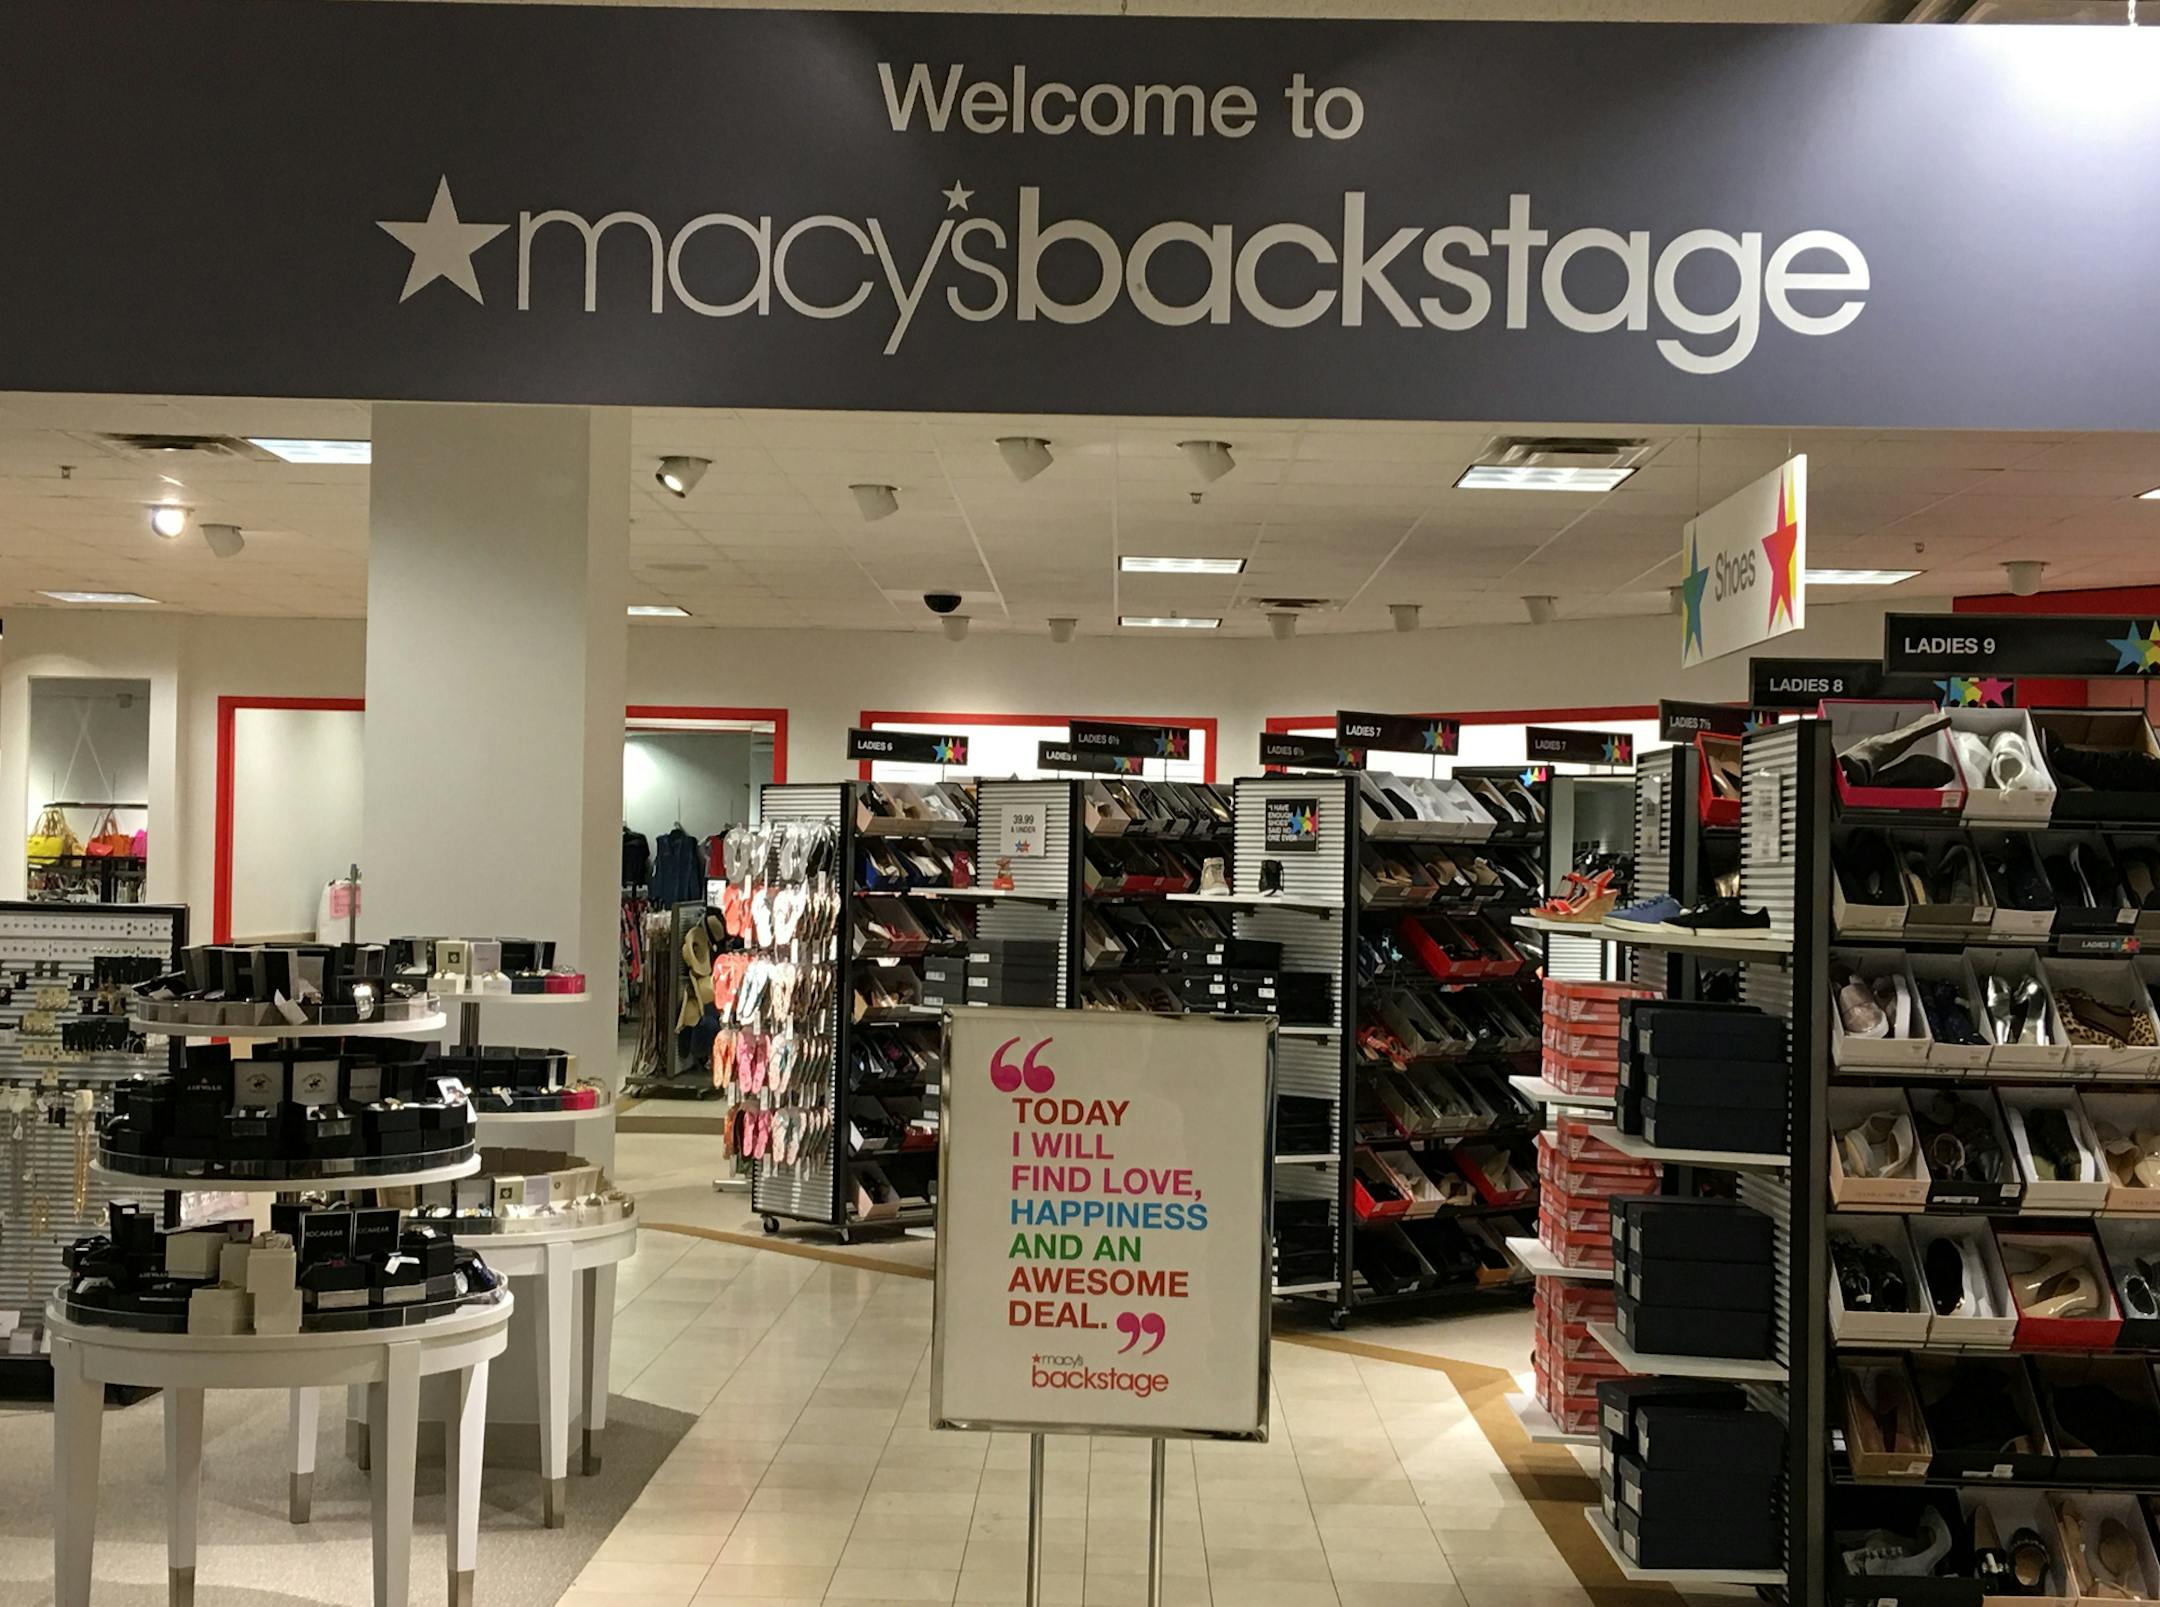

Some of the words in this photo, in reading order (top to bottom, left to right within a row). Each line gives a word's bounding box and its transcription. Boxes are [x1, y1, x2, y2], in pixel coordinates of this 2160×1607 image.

[877, 62, 1257, 138] Welcome
[1285, 73, 1365, 139] to
[517, 180, 1008, 355] macy's
[1016, 186, 1871, 374] backstage
[1714, 549, 1757, 601] Shoes
[1904, 637, 1979, 655] LADIES
[1983, 638, 1996, 655] 9
[1769, 678, 1830, 692] LADIES
[1833, 679, 1844, 693] 8
[1345, 724, 1375, 737] LADIES
[1376, 727, 1382, 737] 7
[1669, 715, 1699, 728] LADIES
[857, 740, 886, 751] LADIES
[887, 742, 893, 751] 6
[1078, 733, 1107, 744] LADIES
[1267, 745, 1292, 756] LADIES
[1534, 739, 1561, 751] LADIES
[1561, 741, 1567, 751] 7
[1012, 814, 1034, 824] 39.99
[1012, 1098, 1130, 1126] TODAY
[1012, 1131, 1020, 1157] I
[1032, 1132, 1114, 1160] WILL
[1011, 1165, 1091, 1193] FIND
[1103, 1167, 1202, 1201] LOVE,
[1010, 1199, 1208, 1231] HAPPINESS
[1008, 1233, 1083, 1260] AND
[1092, 1235, 1141, 1263] AN
[1008, 1267, 1189, 1298] AWESOME
[1008, 1301, 1107, 1329] DEAL.
[1041, 1354, 1084, 1368] macy's
[1031, 1364, 1169, 1398] backstage
